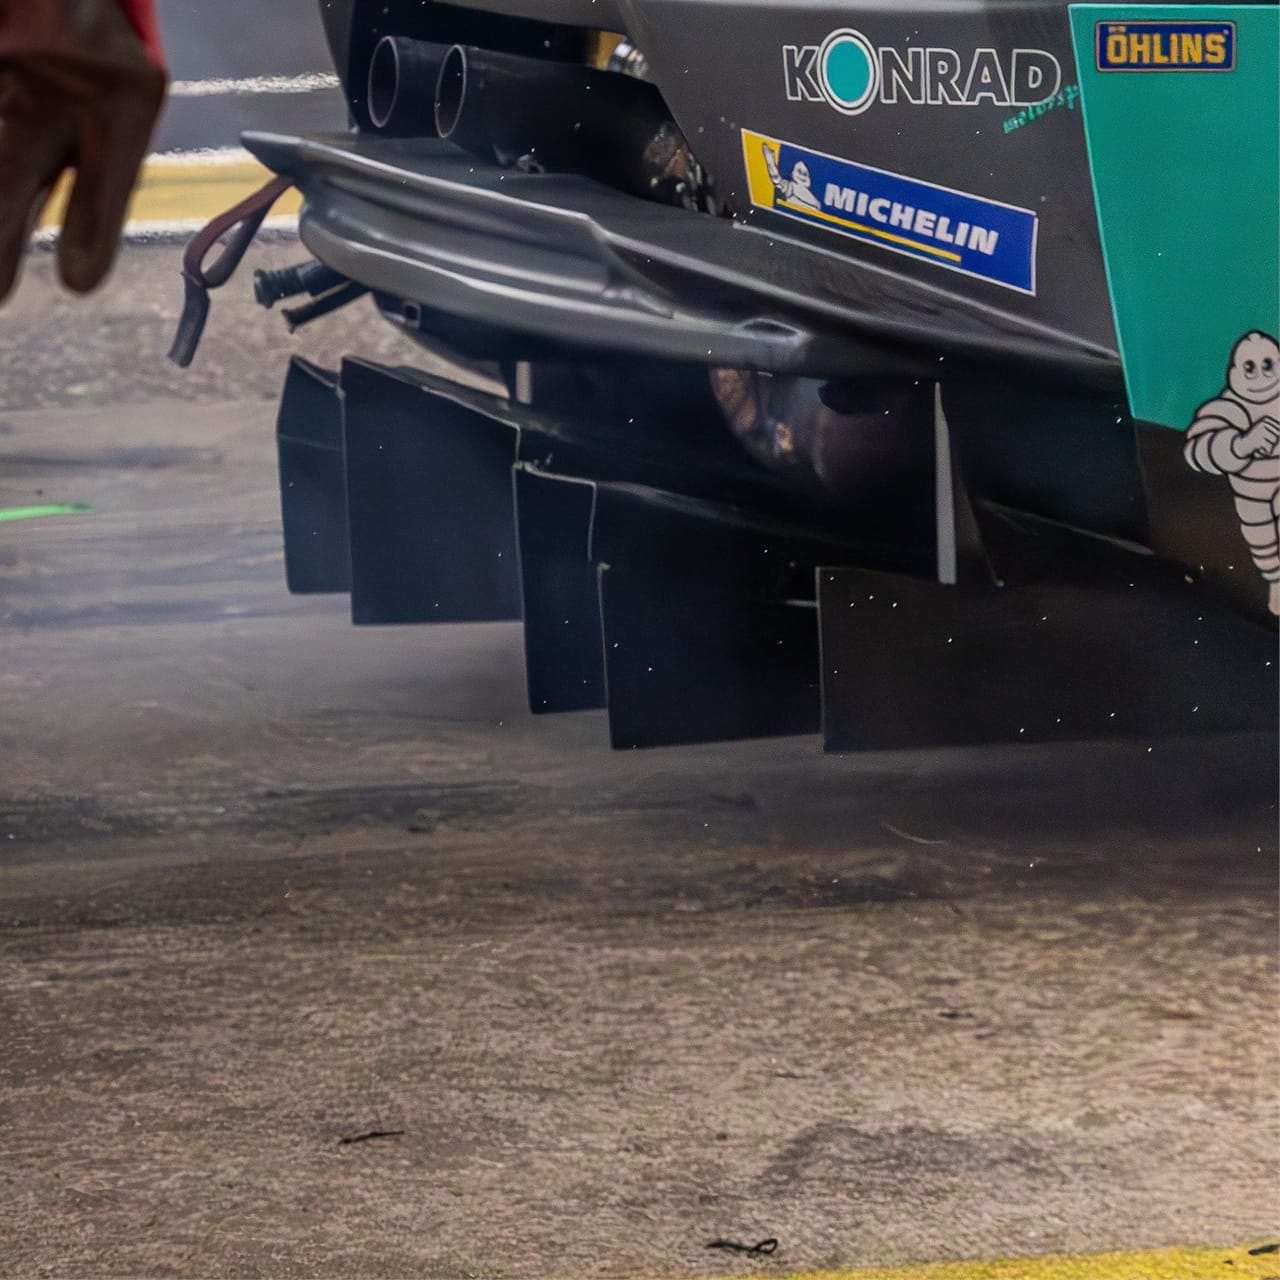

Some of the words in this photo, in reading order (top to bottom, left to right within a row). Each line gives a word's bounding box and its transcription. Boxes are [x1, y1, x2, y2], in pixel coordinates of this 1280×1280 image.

[782, 28, 1062, 115] KONRAD
[1106, 26, 1226, 64] ÖHLINS
[824, 182, 999, 256] MICHELIN
